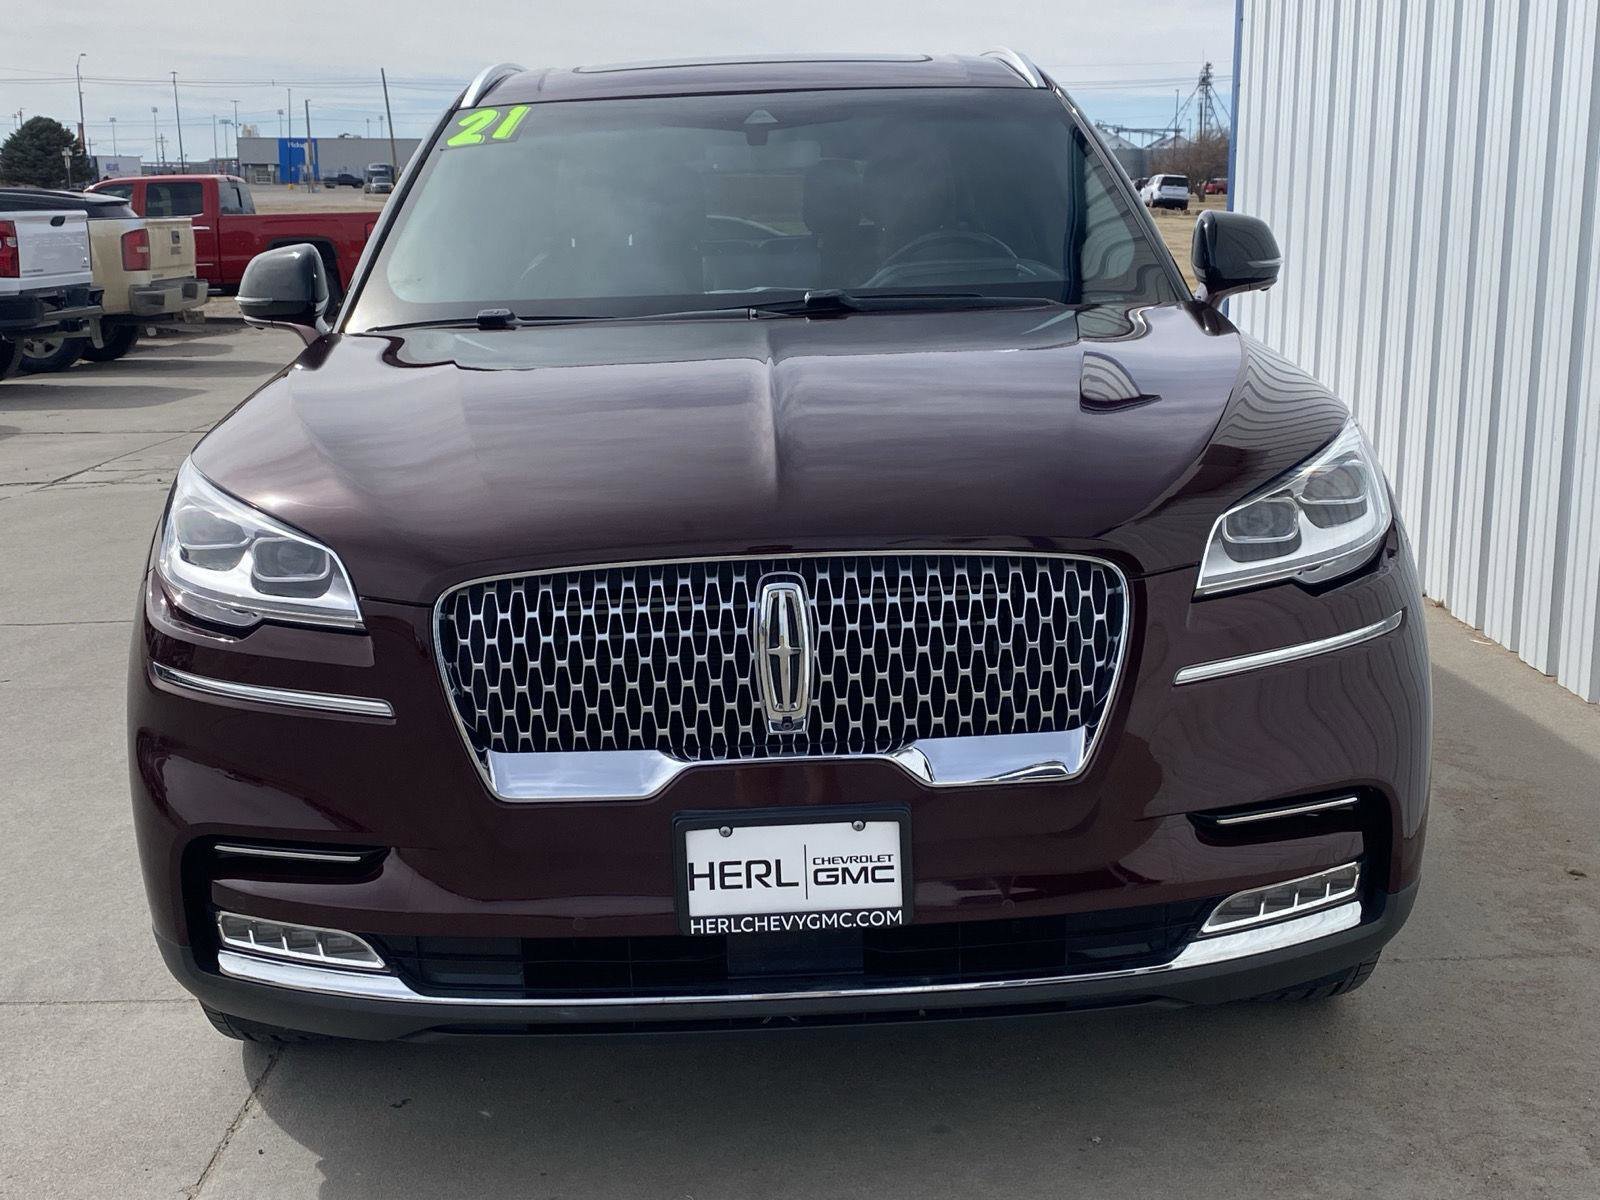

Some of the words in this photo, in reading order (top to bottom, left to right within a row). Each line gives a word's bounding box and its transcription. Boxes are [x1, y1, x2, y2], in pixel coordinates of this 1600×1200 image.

[447, 105, 531, 146] 21
[813, 854, 894, 866] CHEVROLET
[688, 859, 799, 891] HERL
[813, 865, 895, 886] GMC
[690, 910, 903, 935] HERLCHEVYGMC.COM
